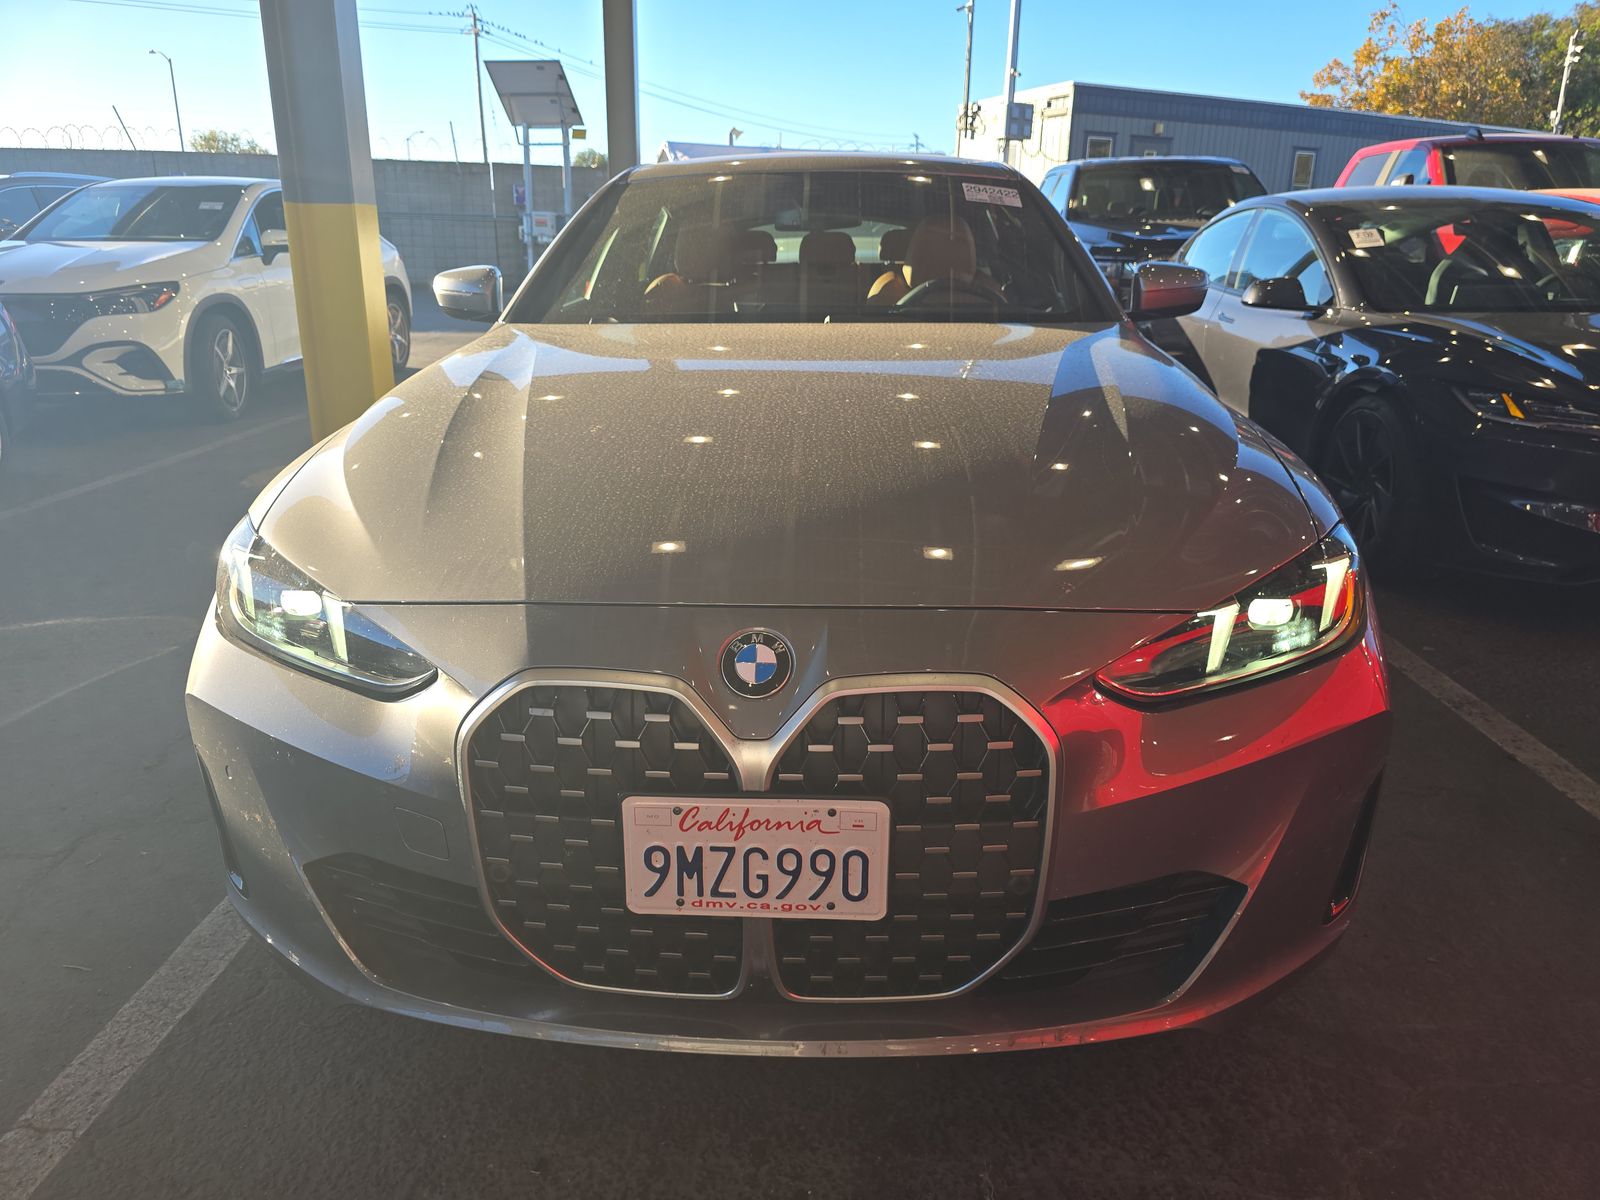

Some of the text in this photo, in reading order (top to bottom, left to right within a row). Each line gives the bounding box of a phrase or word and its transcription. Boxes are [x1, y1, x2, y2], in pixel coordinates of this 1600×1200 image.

[730, 634, 785, 654] BMW
[678, 806, 840, 841] California
[643, 845, 869, 902] 9MZG990
[691, 899, 822, 912] dmv.ca.gov
